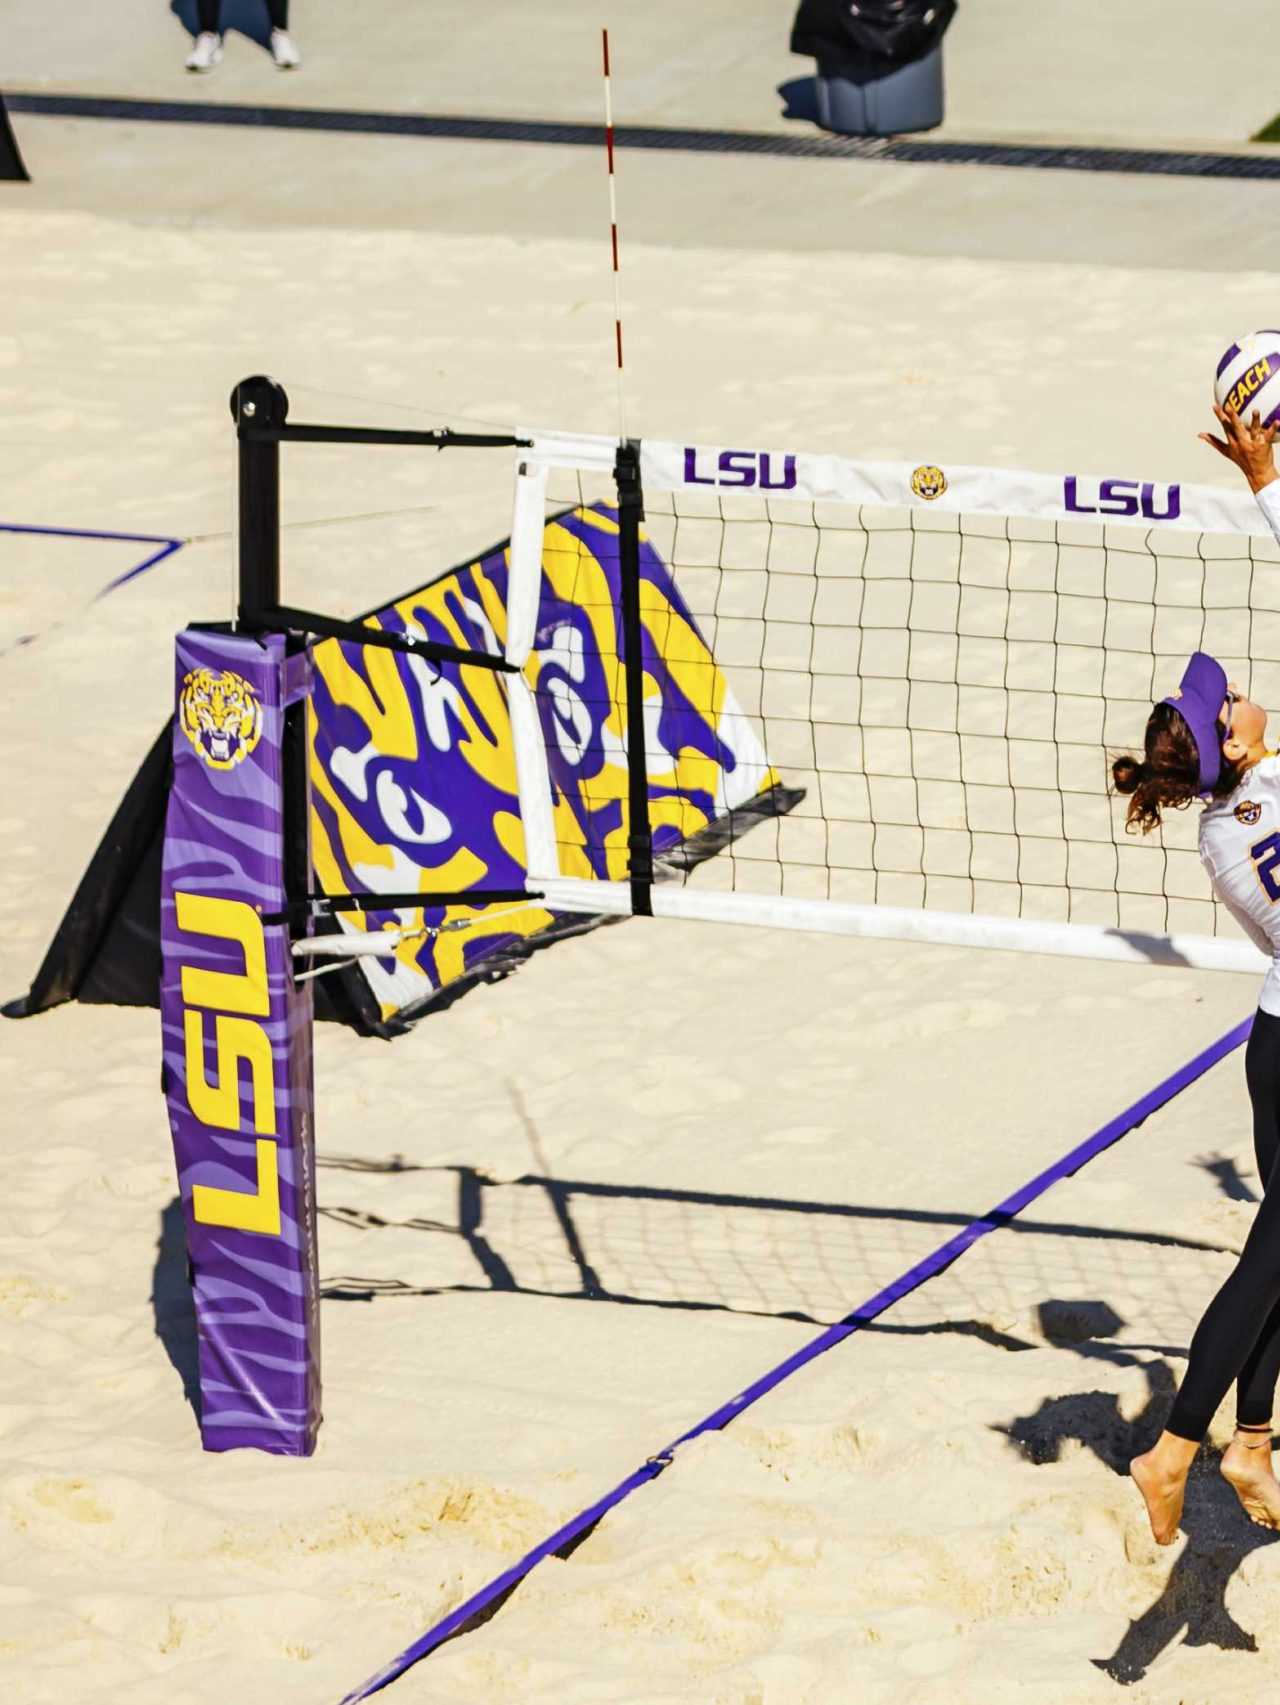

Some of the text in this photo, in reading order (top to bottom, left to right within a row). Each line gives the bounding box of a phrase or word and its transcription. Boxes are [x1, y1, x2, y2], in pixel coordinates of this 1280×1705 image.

[1224, 356, 1272, 415] EACH
[683, 447, 797, 490] LSU
[1063, 475, 1181, 521] LSU
[174, 890, 282, 1237] LSU
